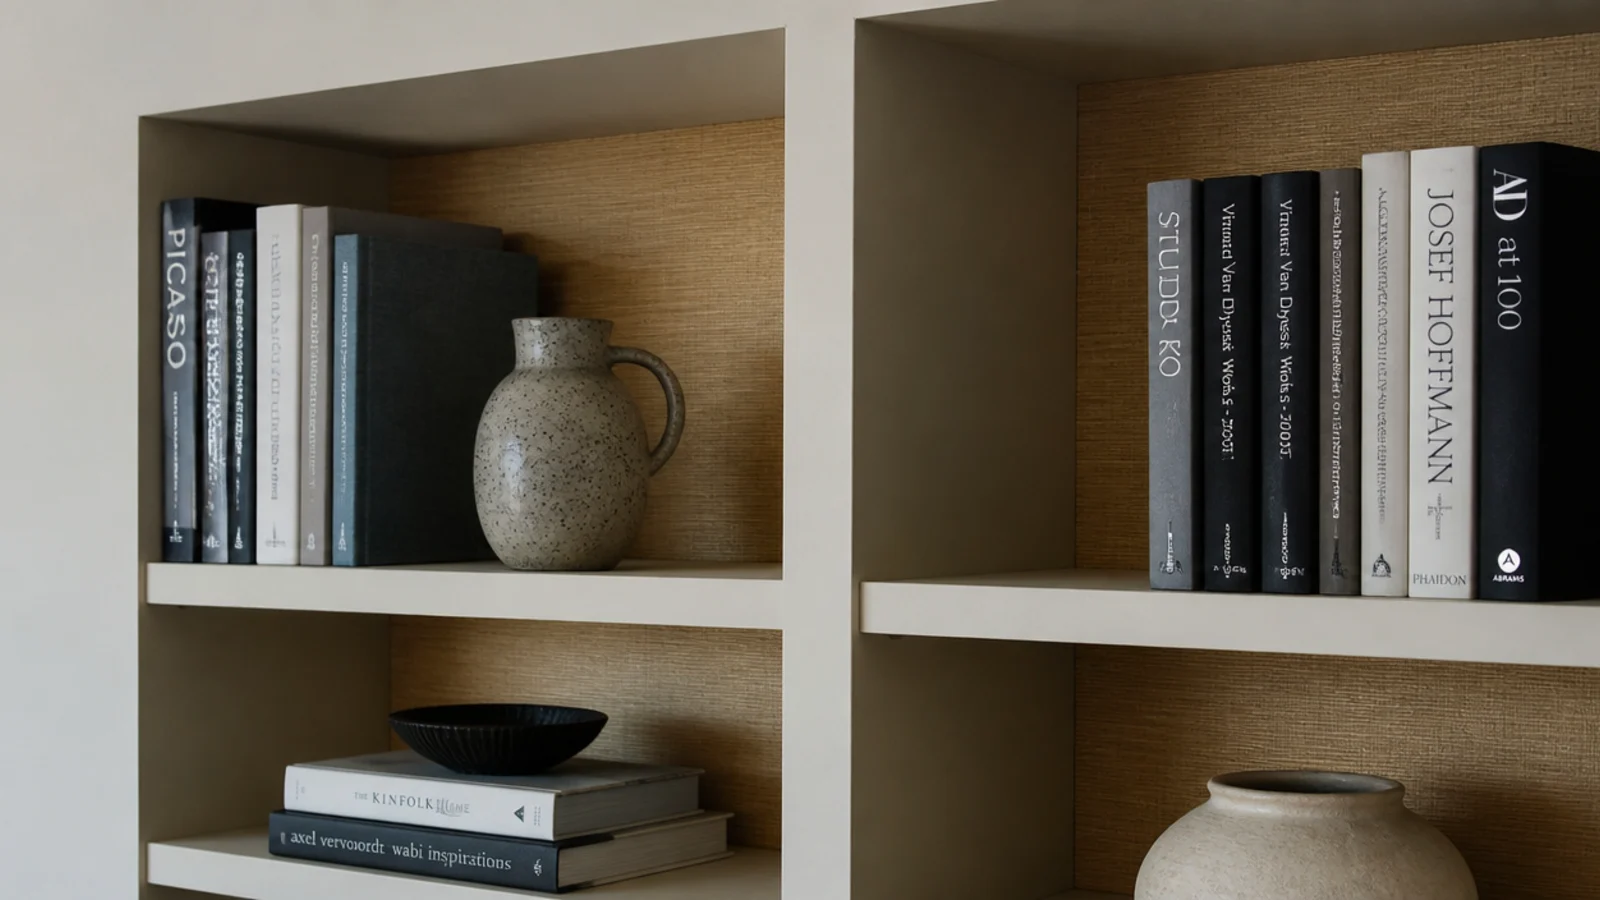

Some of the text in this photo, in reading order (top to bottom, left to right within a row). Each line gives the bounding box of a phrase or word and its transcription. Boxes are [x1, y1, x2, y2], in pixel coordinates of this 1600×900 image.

[1426, 188, 1455, 284] JOSEF
[1492, 168, 1528, 330] AD at 100
[166, 228, 187, 369] PICASO
[1427, 296, 1454, 485] HOFFMANN
[1412, 573, 1467, 586] PHAIDON
[1492, 574, 1524, 583] ABRAMS
[372, 791, 434, 810] KINFOLK
[290, 830, 316, 846] axel
[391, 842, 424, 860] wabi
[428, 845, 512, 870] inspirations
